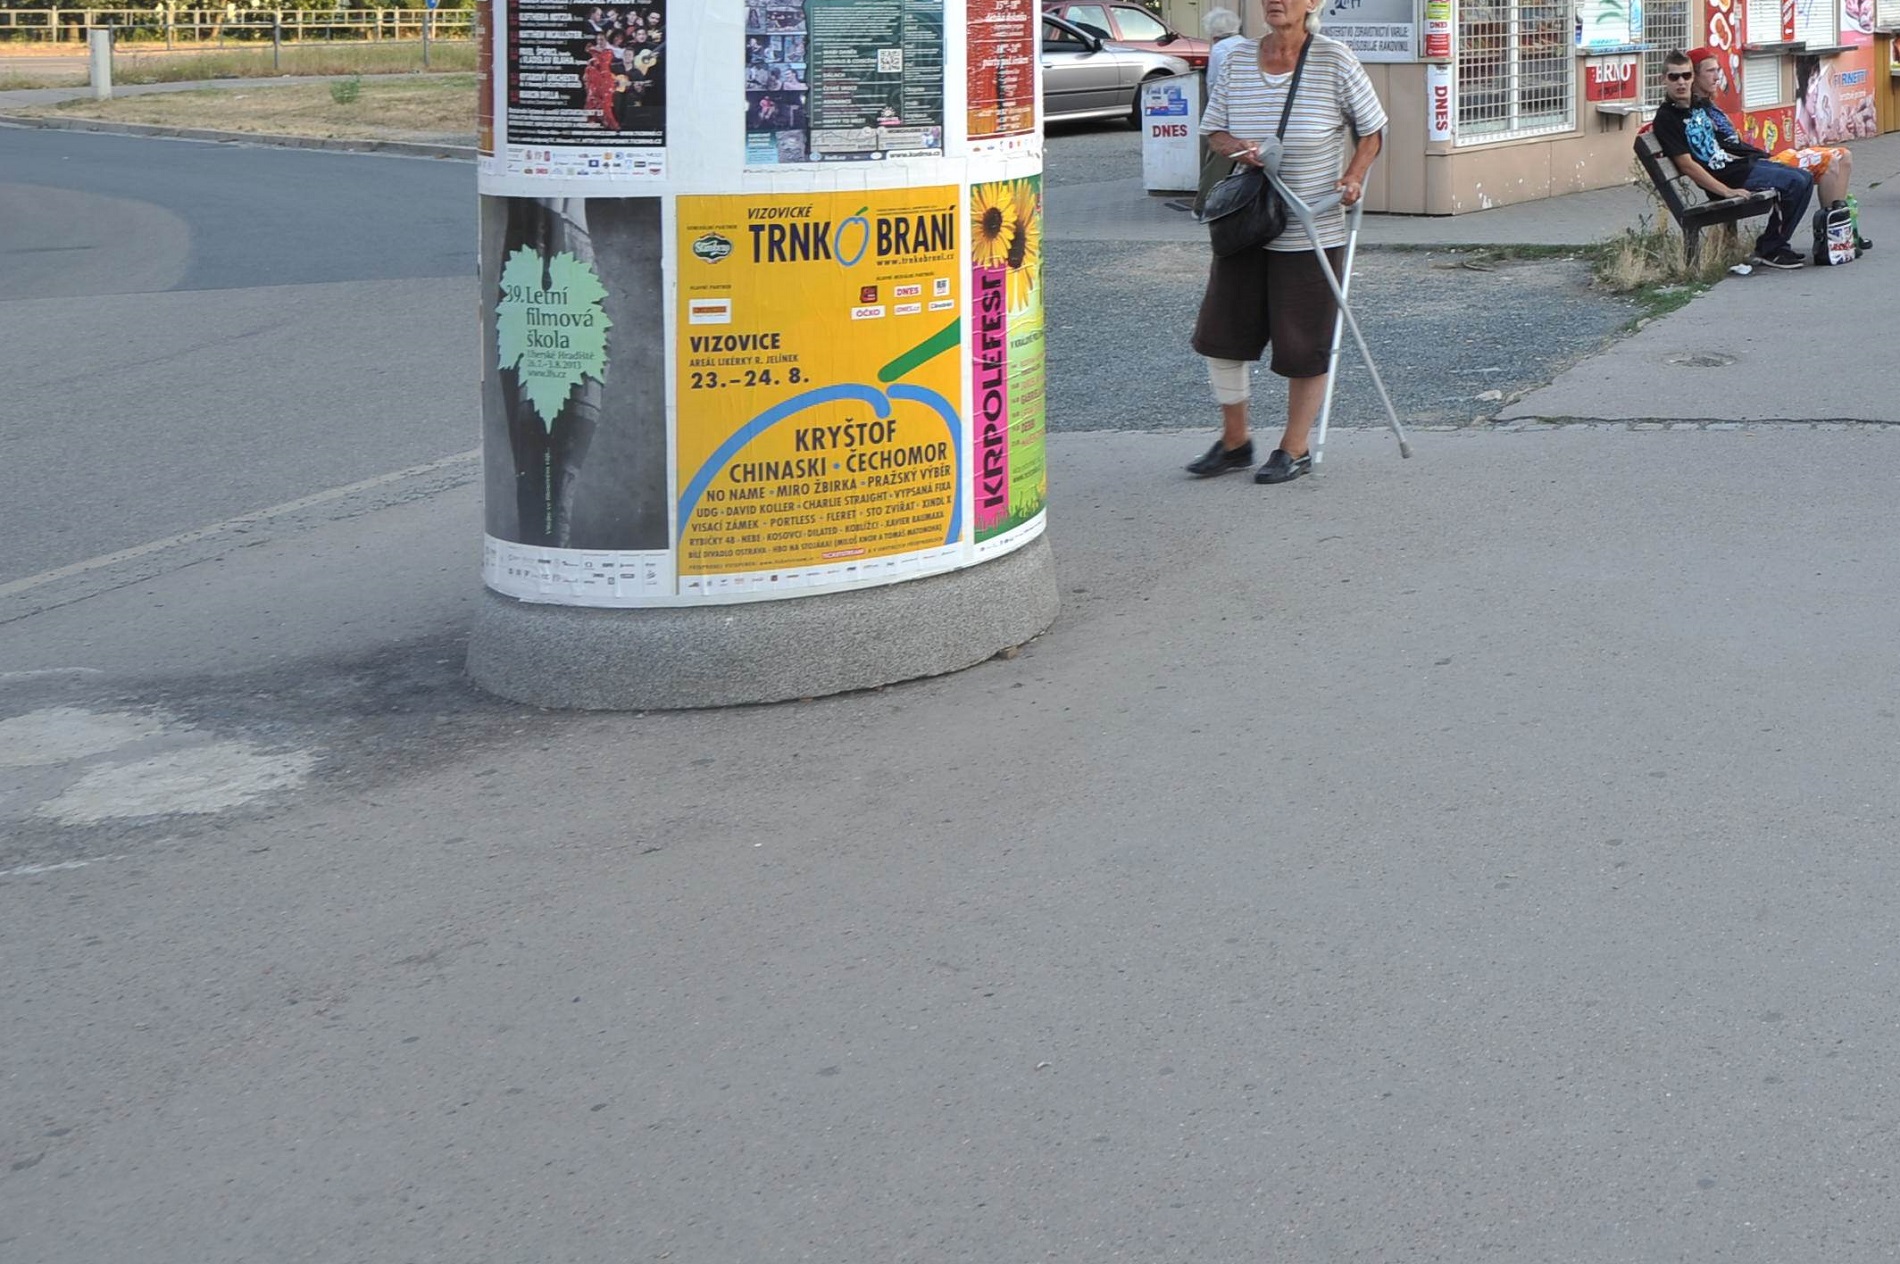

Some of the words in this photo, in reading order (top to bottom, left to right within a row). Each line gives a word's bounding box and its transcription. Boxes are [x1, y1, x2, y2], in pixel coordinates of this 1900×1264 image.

[1595, 62, 1631, 84] BRNO
[1435, 85, 1448, 131] DNES
[1152, 124, 1188, 138] DNES
[747, 203, 813, 220] VIZOVICKÉ
[506, 285, 526, 303] 39.
[526, 286, 569, 305] Letní
[526, 307, 594, 327] filmová
[526, 328, 570, 348] škola
[689, 333, 781, 354] VIZOVICE
[689, 353, 716, 368] AREÁL
[718, 354, 752, 367] LIKÉRKY
[755, 355, 764, 365] R.
[766, 352, 799, 364] JELÍNEK
[788, 367, 810, 384] 8.
[795, 417, 897, 453] KRYŠTOF
[729, 457, 827, 483] CHINASKI
[845, 441, 948, 473] ČECHOMOR
[706, 490, 726, 502] NO
[729, 488, 765, 501] NAME
[776, 483, 811, 498] MIRO
[814, 477, 858, 495] ŽBIRKA
[867, 470, 917, 488] PRAŽSKÝ
[920, 463, 951, 480] VÝBĚR
[696, 507, 719, 518] UDG
[726, 505, 757, 517] DAVID
[759, 502, 795, 514] KOLLER
[802, 497, 842, 511] CHARLIE
[844, 491, 888, 506] STRAIGHT
[893, 482, 933, 499] VYPSANÁ
[934, 481, 952, 492] FIXA
[691, 522, 723, 533] VISACÍ
[725, 519, 759, 531] ZÁMEK
[769, 513, 816, 528] PORTLESS
[826, 509, 857, 522] FLERET
[866, 507, 883, 517] STO
[885, 500, 916, 514] ZVÍŘAT
[922, 495, 945, 509] XINDL
[741, 534, 761, 543] NEBE
[806, 526, 838, 539] DILATED
